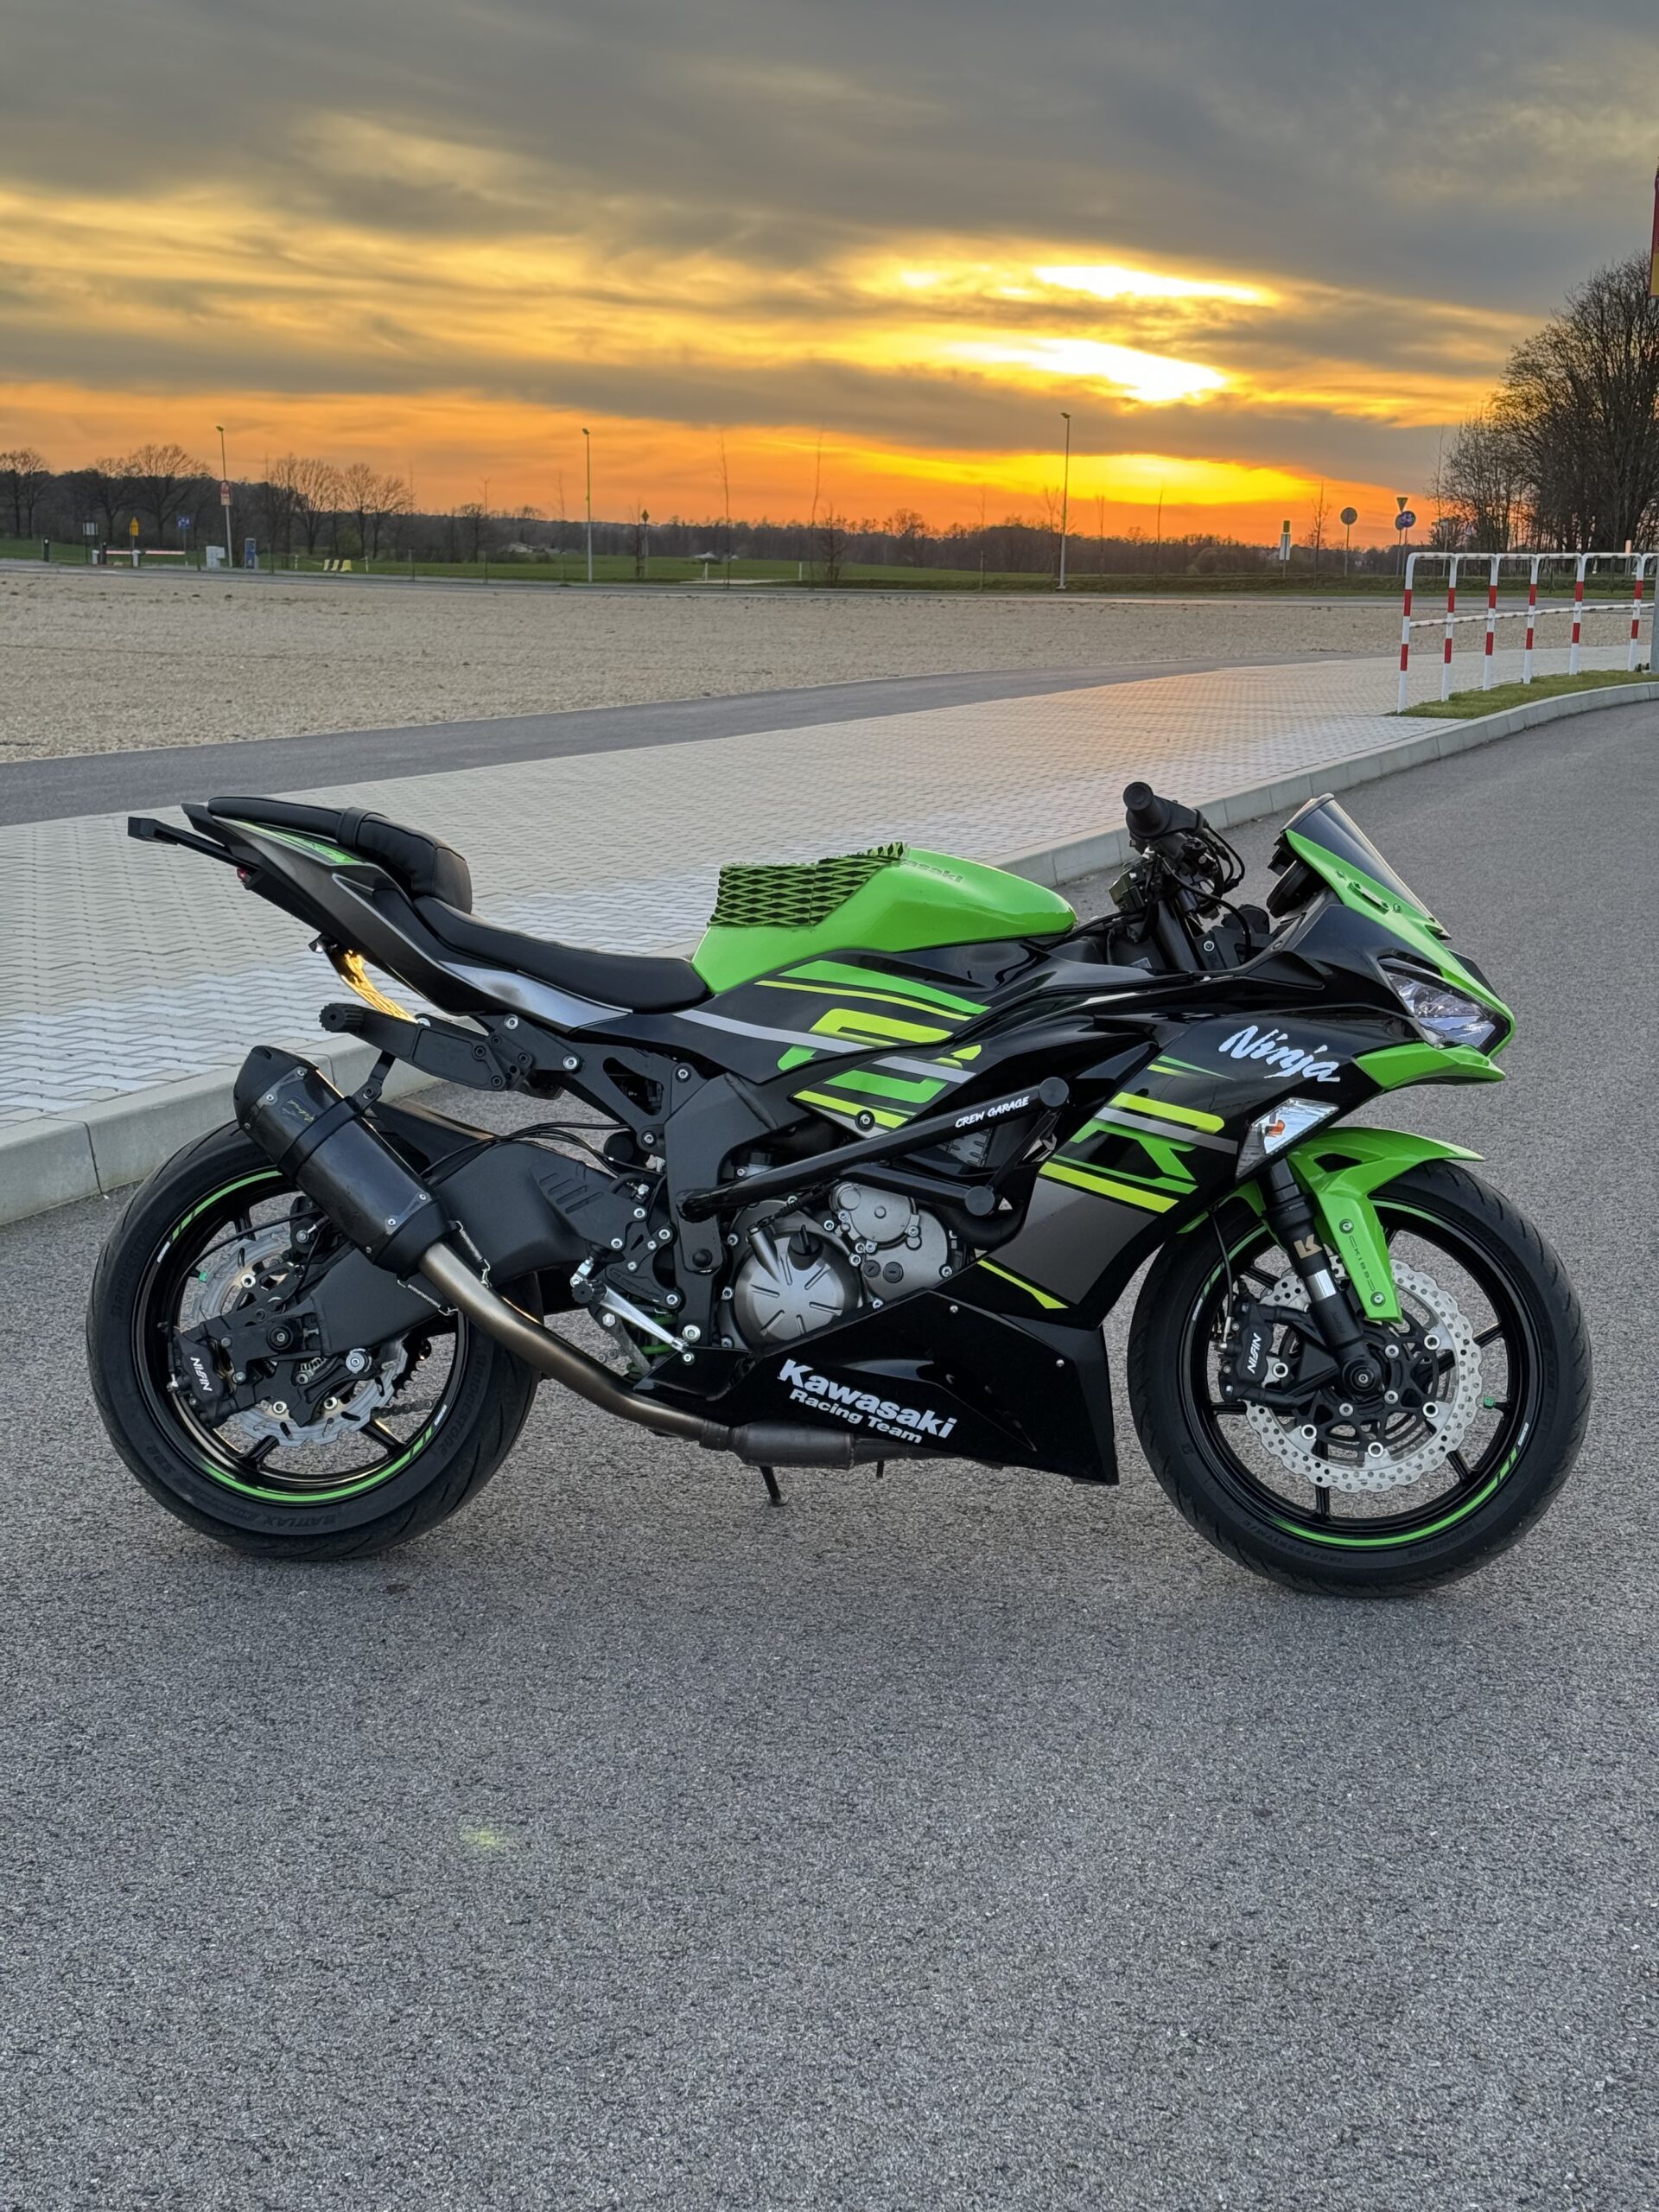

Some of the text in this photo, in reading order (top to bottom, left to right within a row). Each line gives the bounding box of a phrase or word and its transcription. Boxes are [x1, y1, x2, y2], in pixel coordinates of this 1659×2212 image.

[1218, 1026, 1340, 1083] Ninja
[955, 1096, 1030, 1128] CREW GARAGE
[778, 1358, 957, 1439] Kawasaki
[789, 1389, 923, 1444] Racing Team
